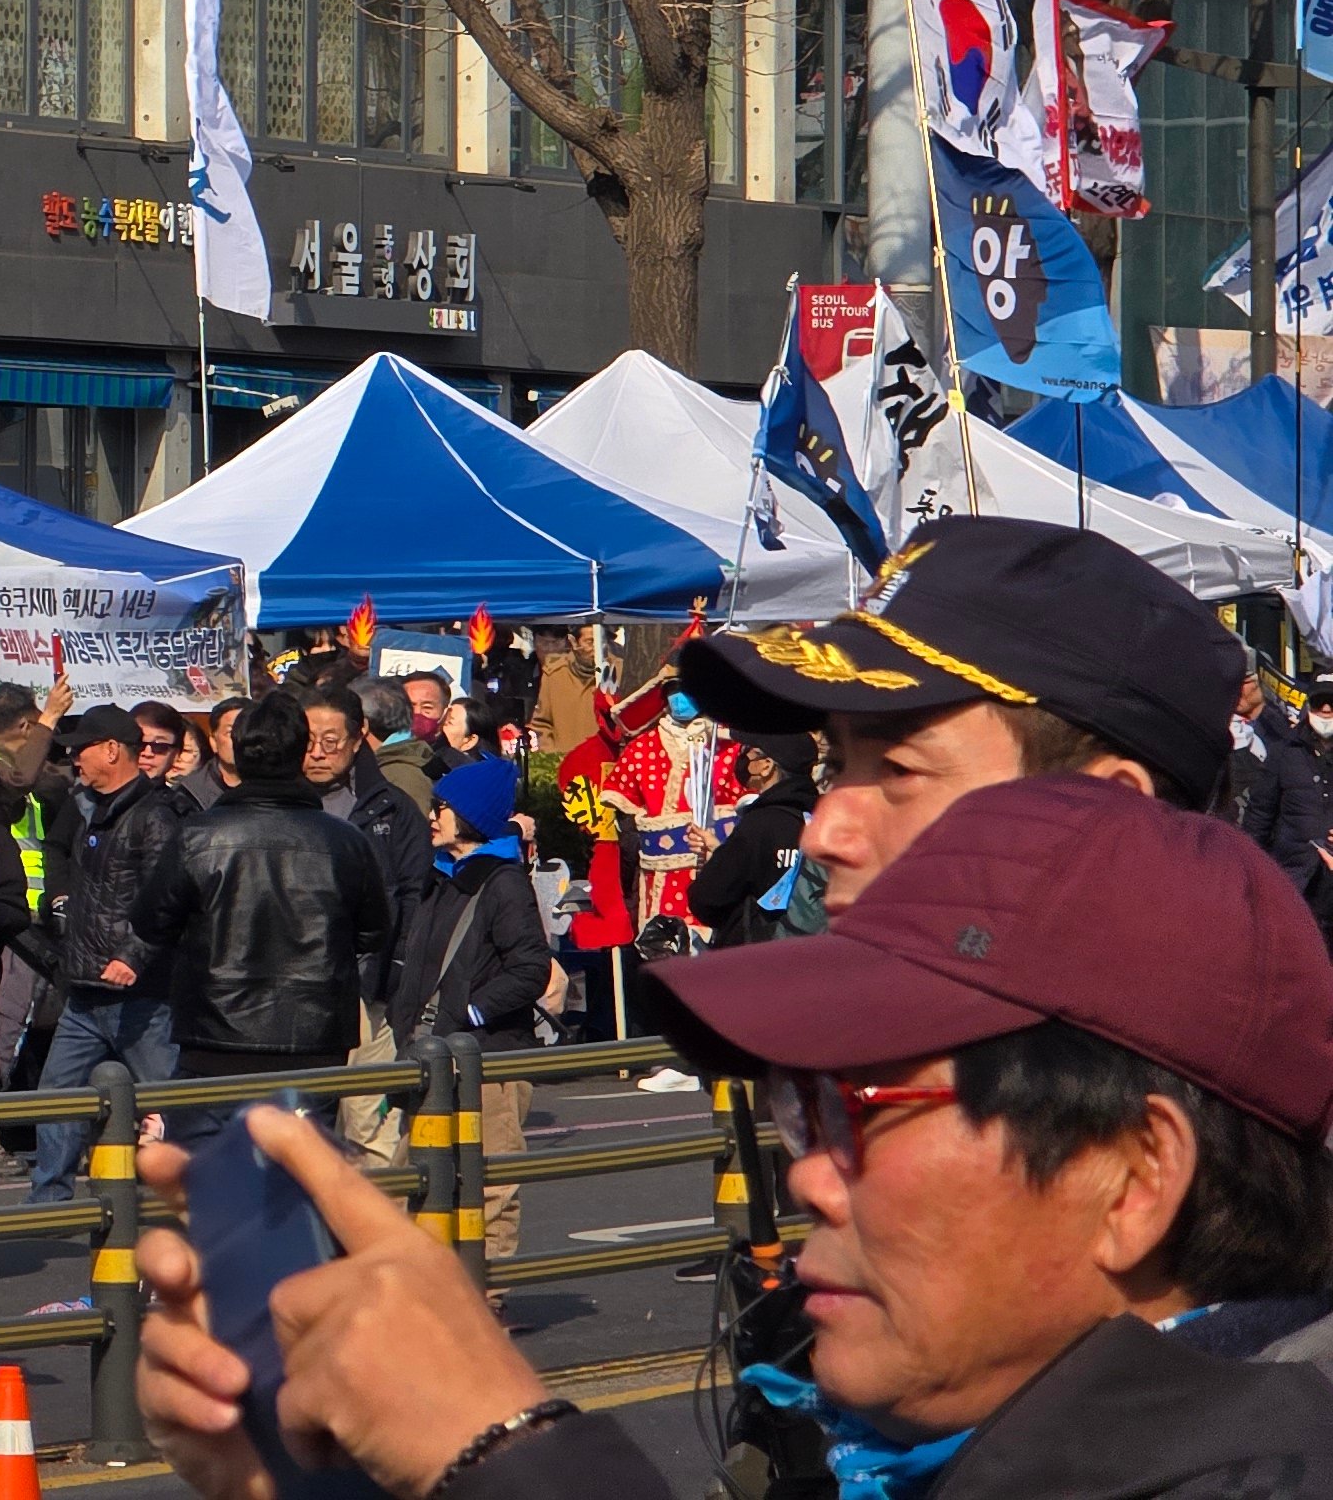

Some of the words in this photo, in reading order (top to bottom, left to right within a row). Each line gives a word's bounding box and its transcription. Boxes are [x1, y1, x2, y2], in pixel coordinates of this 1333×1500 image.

[177, 202, 194, 246] 한
[290, 219, 363, 296] 서울
[403, 229, 477, 302] 상회
[971, 224, 1031, 320] 앙
[811, 294, 848, 306] SEOUL
[811, 306, 838, 317] CITY
[841, 306, 870, 317] TOUR
[811, 318, 834, 329] BUS
[63, 588, 114, 620] 핵사고
[119, 589, 156, 619] 14년
[115, 630, 151, 667] 즉각
[152, 627, 225, 670] 중단하라
